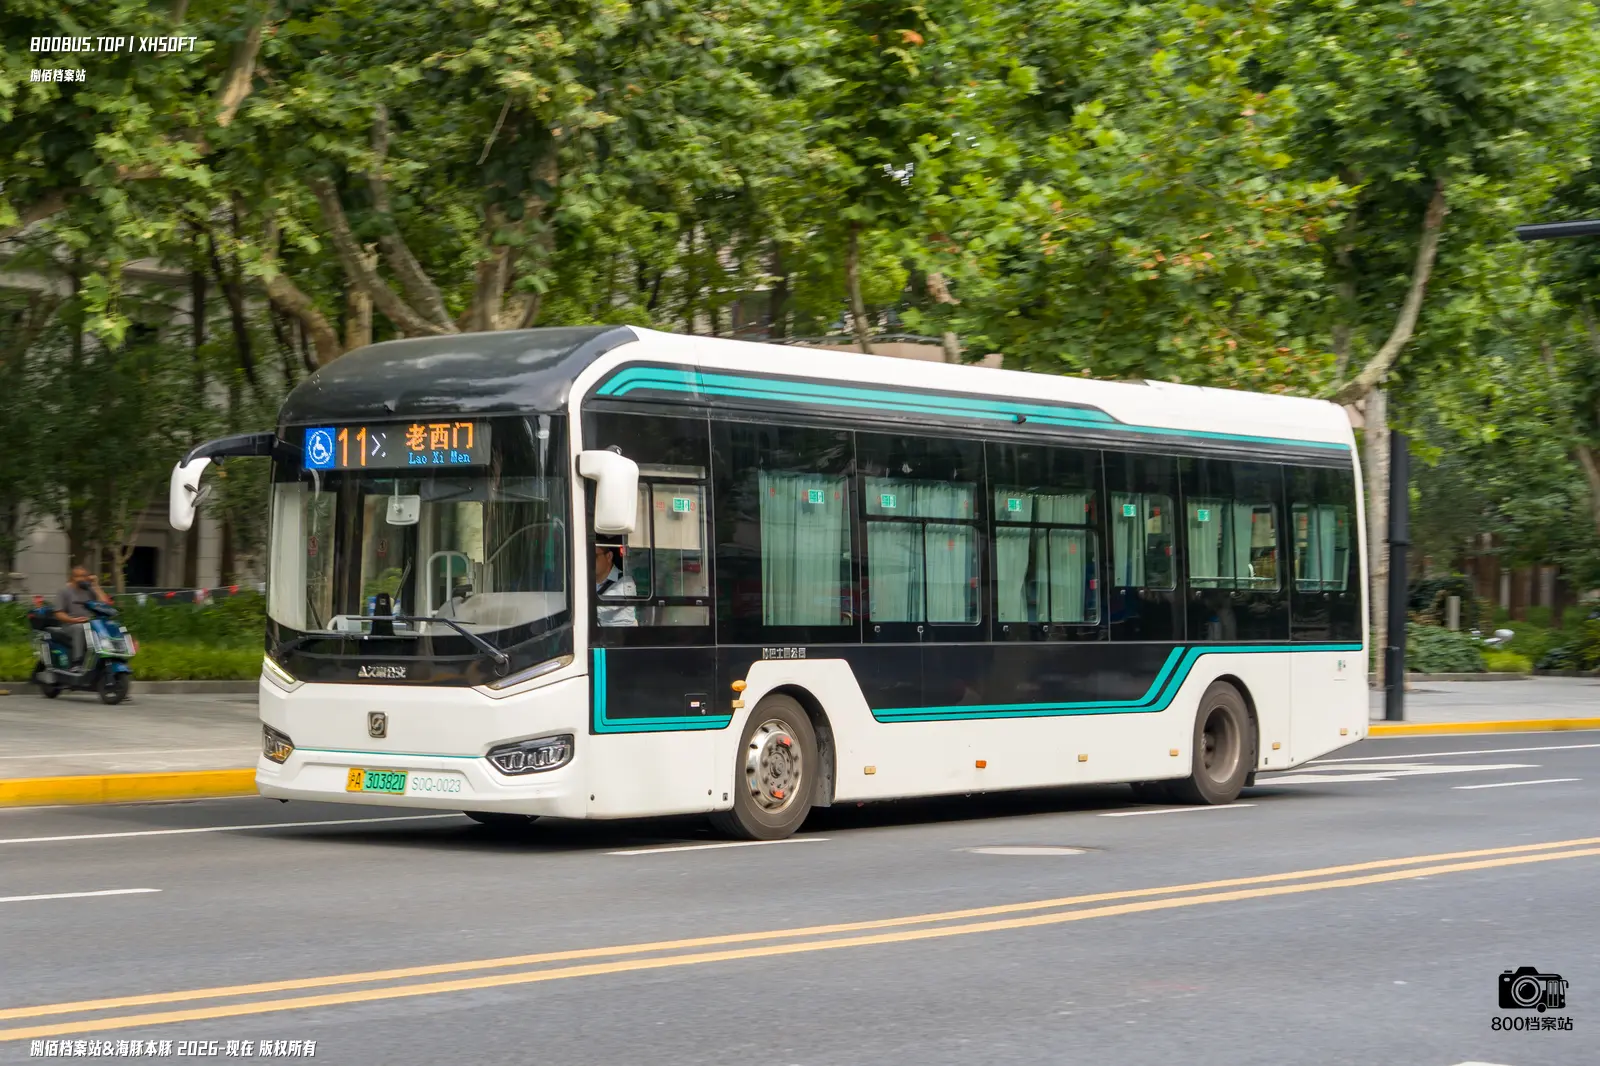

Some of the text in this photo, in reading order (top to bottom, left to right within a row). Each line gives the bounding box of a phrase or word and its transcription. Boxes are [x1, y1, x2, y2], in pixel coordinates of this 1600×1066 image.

[338, 427, 367, 466] 11
[405, 422, 473, 451] 老西门
[408, 450, 471, 464] Lao Xi Men
